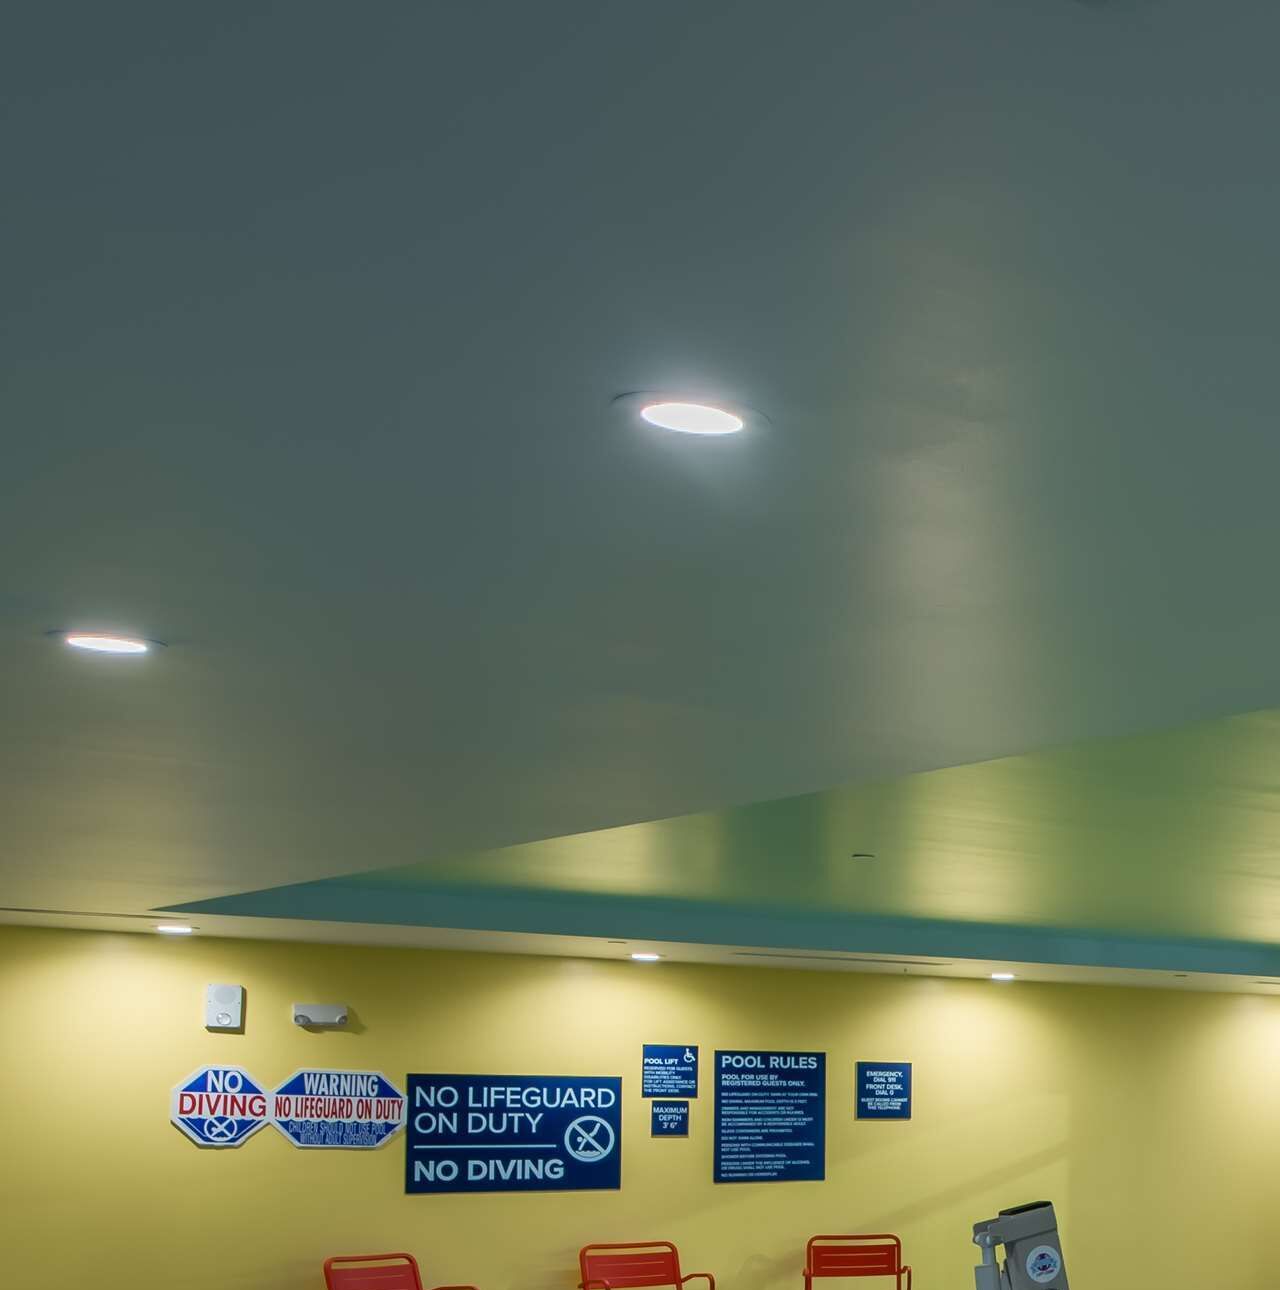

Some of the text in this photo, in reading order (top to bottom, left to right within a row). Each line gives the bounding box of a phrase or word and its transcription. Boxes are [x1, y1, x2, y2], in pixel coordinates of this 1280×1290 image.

[722, 1056, 817, 1069] POOL RULES
[207, 1070, 242, 1092] NO
[304, 1073, 379, 1096] WARNING
[178, 1093, 267, 1116] DIVING
[274, 1096, 403, 1120] NO LIFEGUARD ON DUTY
[415, 1086, 616, 1109] NO LIFEGUARD
[289, 1121, 386, 1135] CHILDREN SHOULD NOT USE POOL
[414, 1112, 543, 1134] ON DUTY
[300, 1133, 377, 1145] WITHOUT ADULT SUPERVISION
[414, 1158, 565, 1182] NO DIVING
